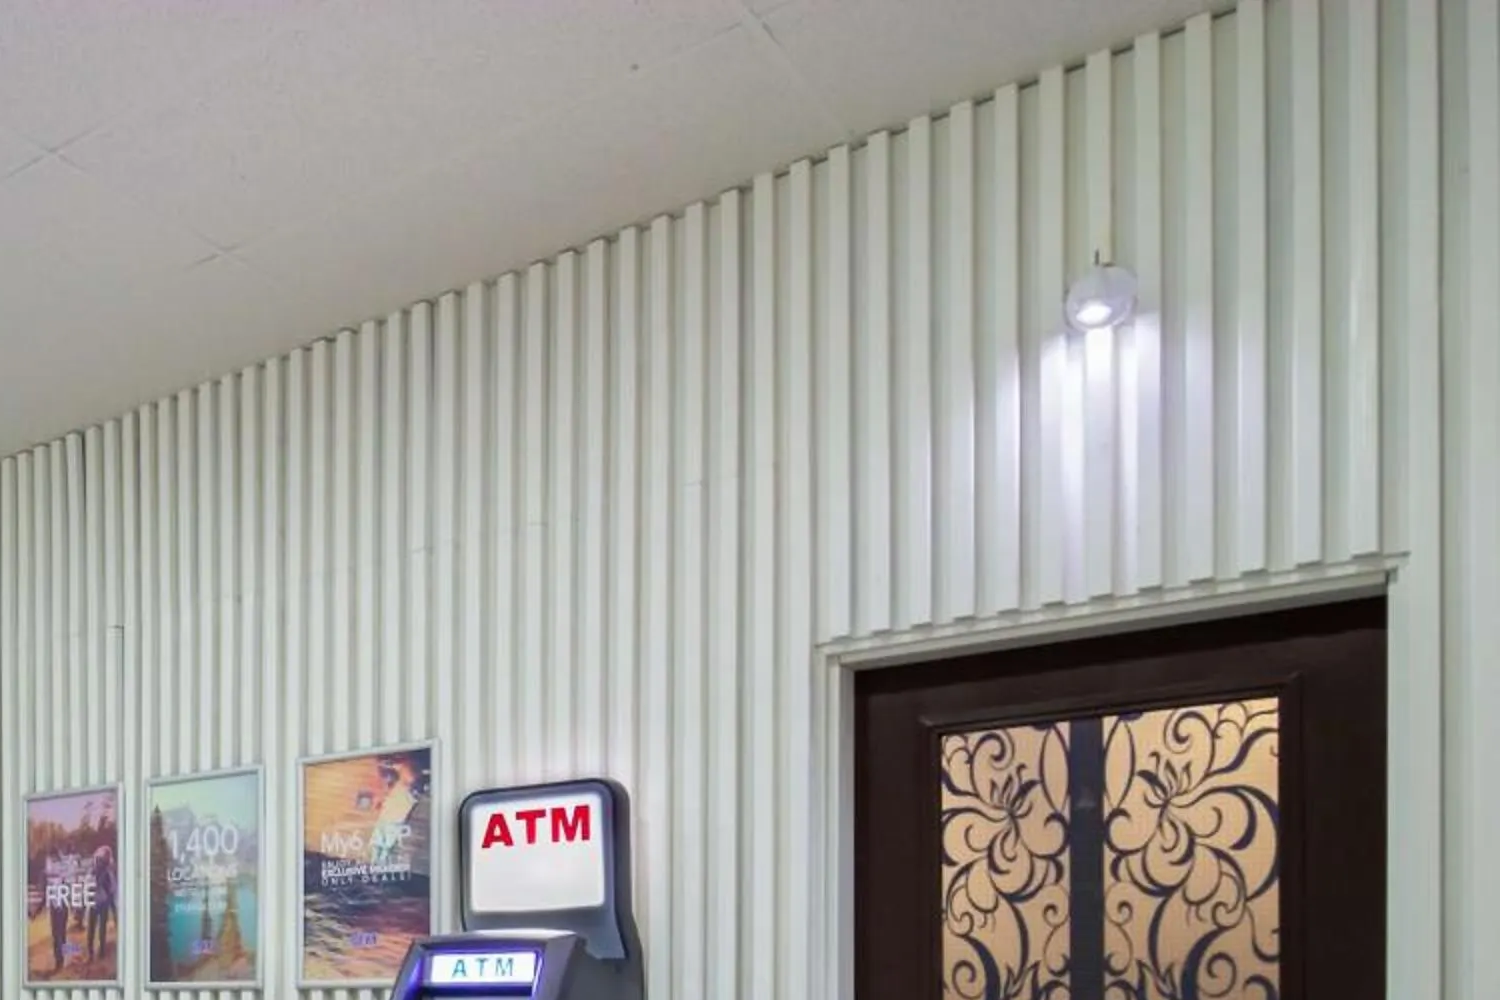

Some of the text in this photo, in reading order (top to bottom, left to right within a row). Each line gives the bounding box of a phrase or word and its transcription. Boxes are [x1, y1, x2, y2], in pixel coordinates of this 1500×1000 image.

[481, 805, 594, 849] ATM
[170, 824, 239, 864] 1,400
[45, 881, 97, 908] FREE
[451, 957, 515, 978] ATM
